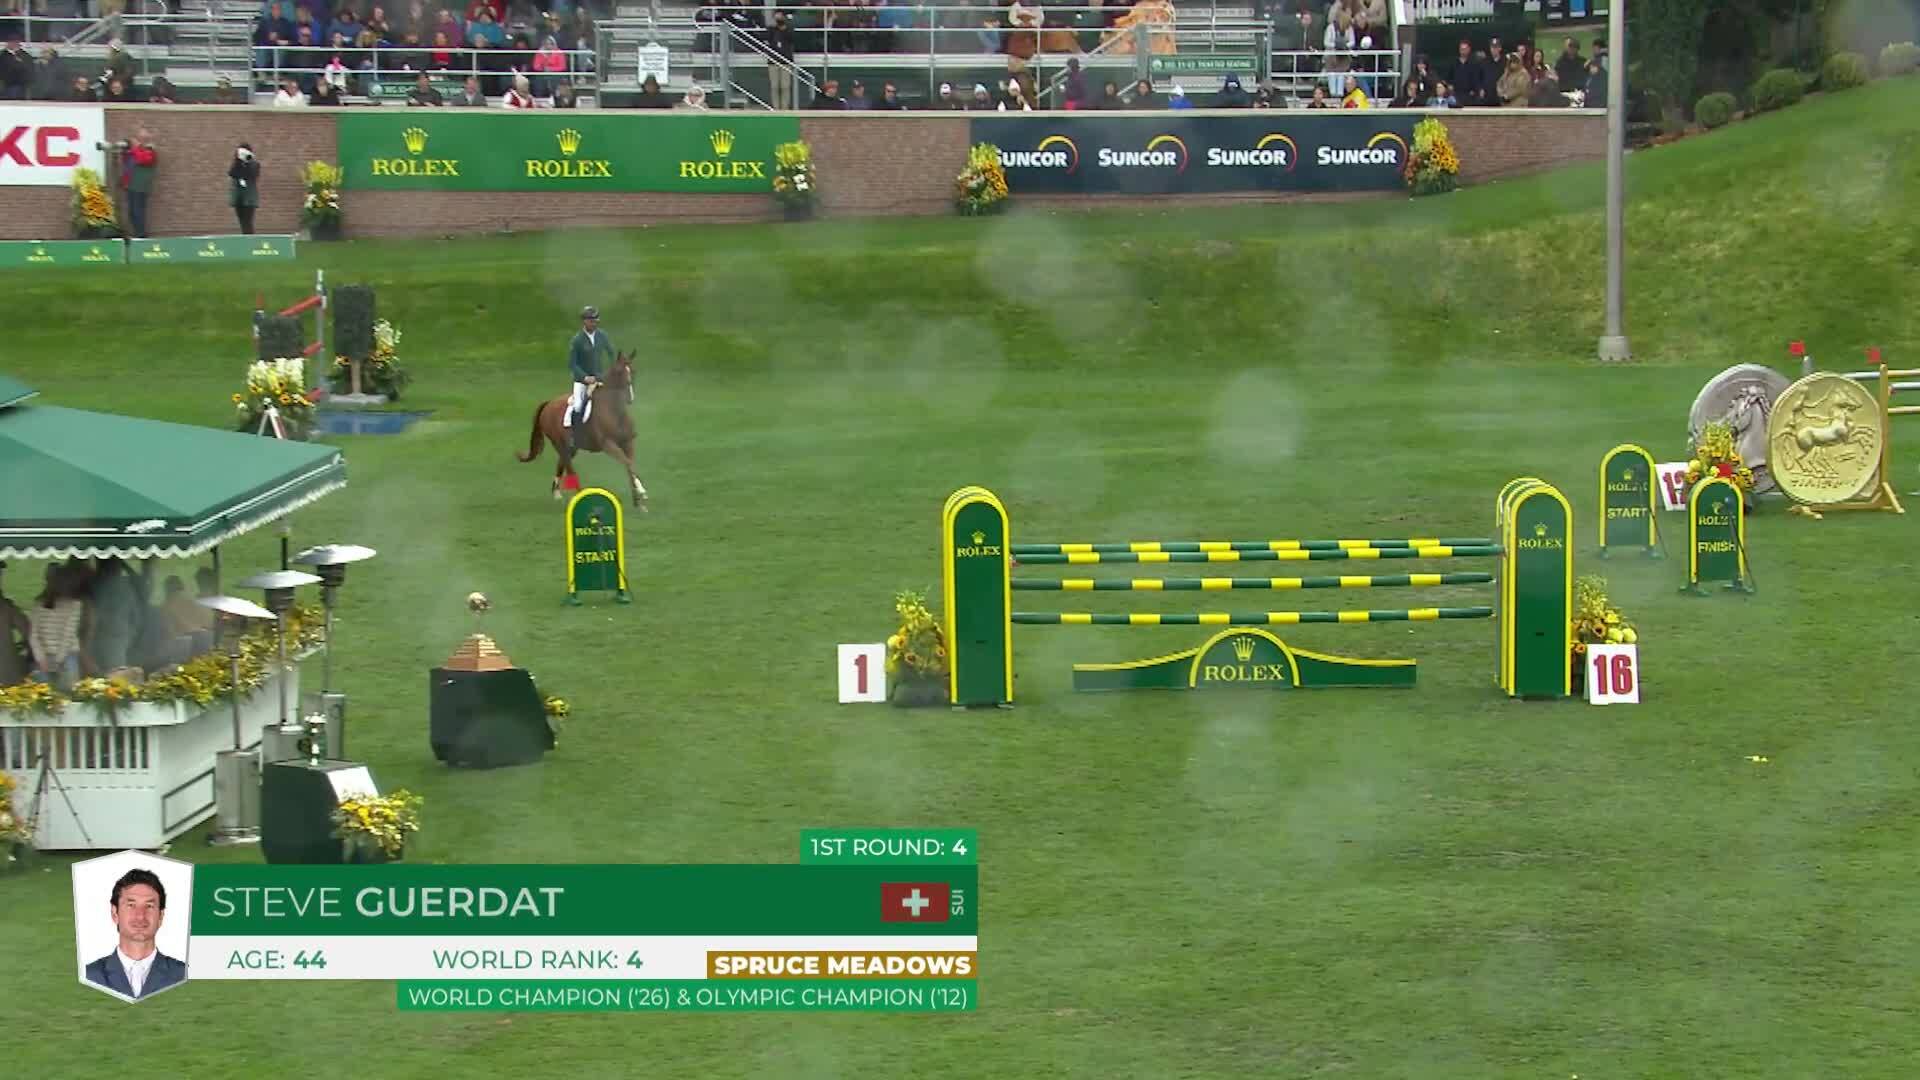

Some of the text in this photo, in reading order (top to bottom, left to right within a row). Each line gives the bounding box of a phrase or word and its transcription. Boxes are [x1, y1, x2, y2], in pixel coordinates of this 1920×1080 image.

[1098, 148, 1177, 168] SUNCOR
[1207, 147, 1287, 167] SUNCOR
[1317, 146, 1397, 166] SUNCOR
[372, 159, 460, 177] ROLEX
[526, 159, 612, 178] ROLEX
[680, 161, 765, 179] ROLEX
[1607, 507, 1648, 519] START
[1698, 514, 1736, 526] ROLE
[957, 545, 1000, 557] ROLEX
[1519, 538, 1562, 549] ROLEX
[1698, 541, 1736, 553] FINISH
[575, 550, 616, 564] START
[854, 654, 868, 694] 1
[1204, 664, 1285, 682] ROLEX
[1593, 654, 1633, 695] 16
